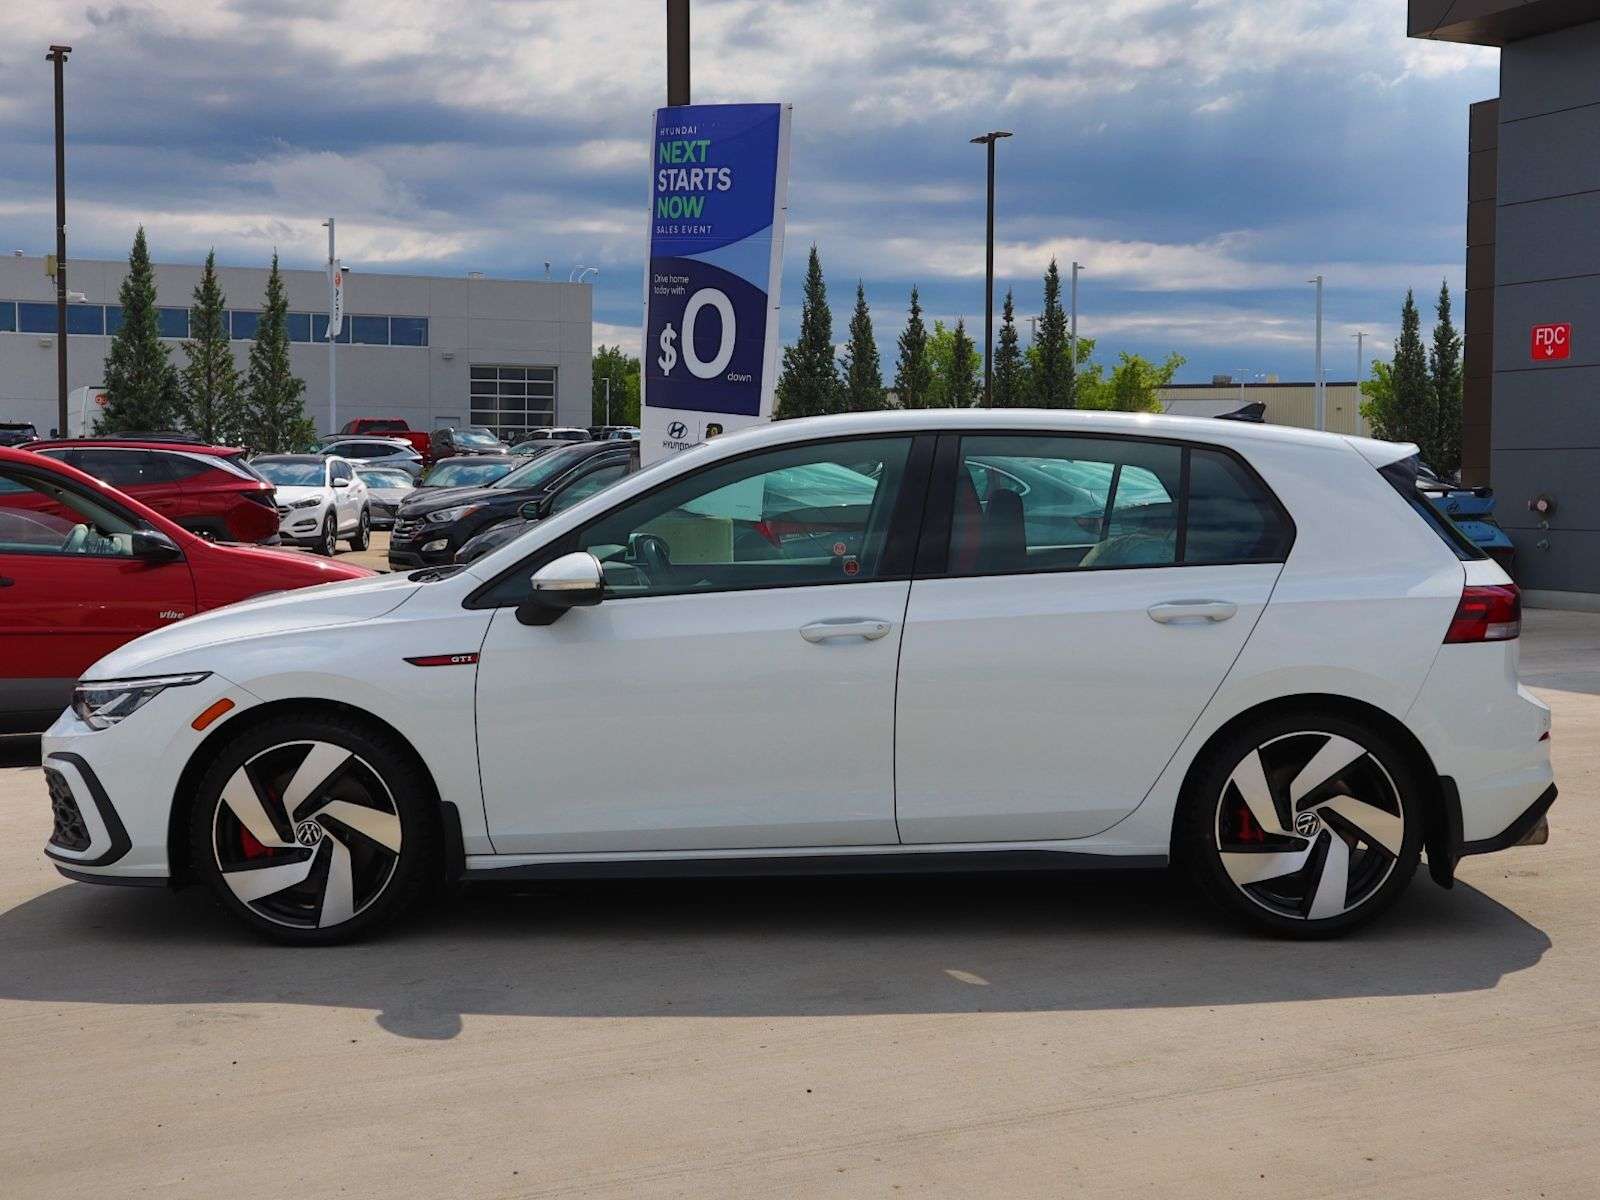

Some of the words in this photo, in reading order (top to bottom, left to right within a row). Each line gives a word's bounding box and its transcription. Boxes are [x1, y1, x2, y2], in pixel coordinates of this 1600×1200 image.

[660, 126, 697, 136] HYUNDAI
[659, 140, 711, 164] NEXT
[658, 167, 732, 192] STARTS
[657, 196, 705, 219] NOW
[656, 225, 679, 234] SALES
[681, 225, 712, 234] EVENT
[655, 274, 668, 283] Drive
[669, 274, 689, 284] home
[654, 286, 670, 296] today
[671, 284, 686, 295] with
[1535, 326, 1566, 346] FDC
[727, 371, 752, 382] down
[450, 655, 473, 663] GTI
